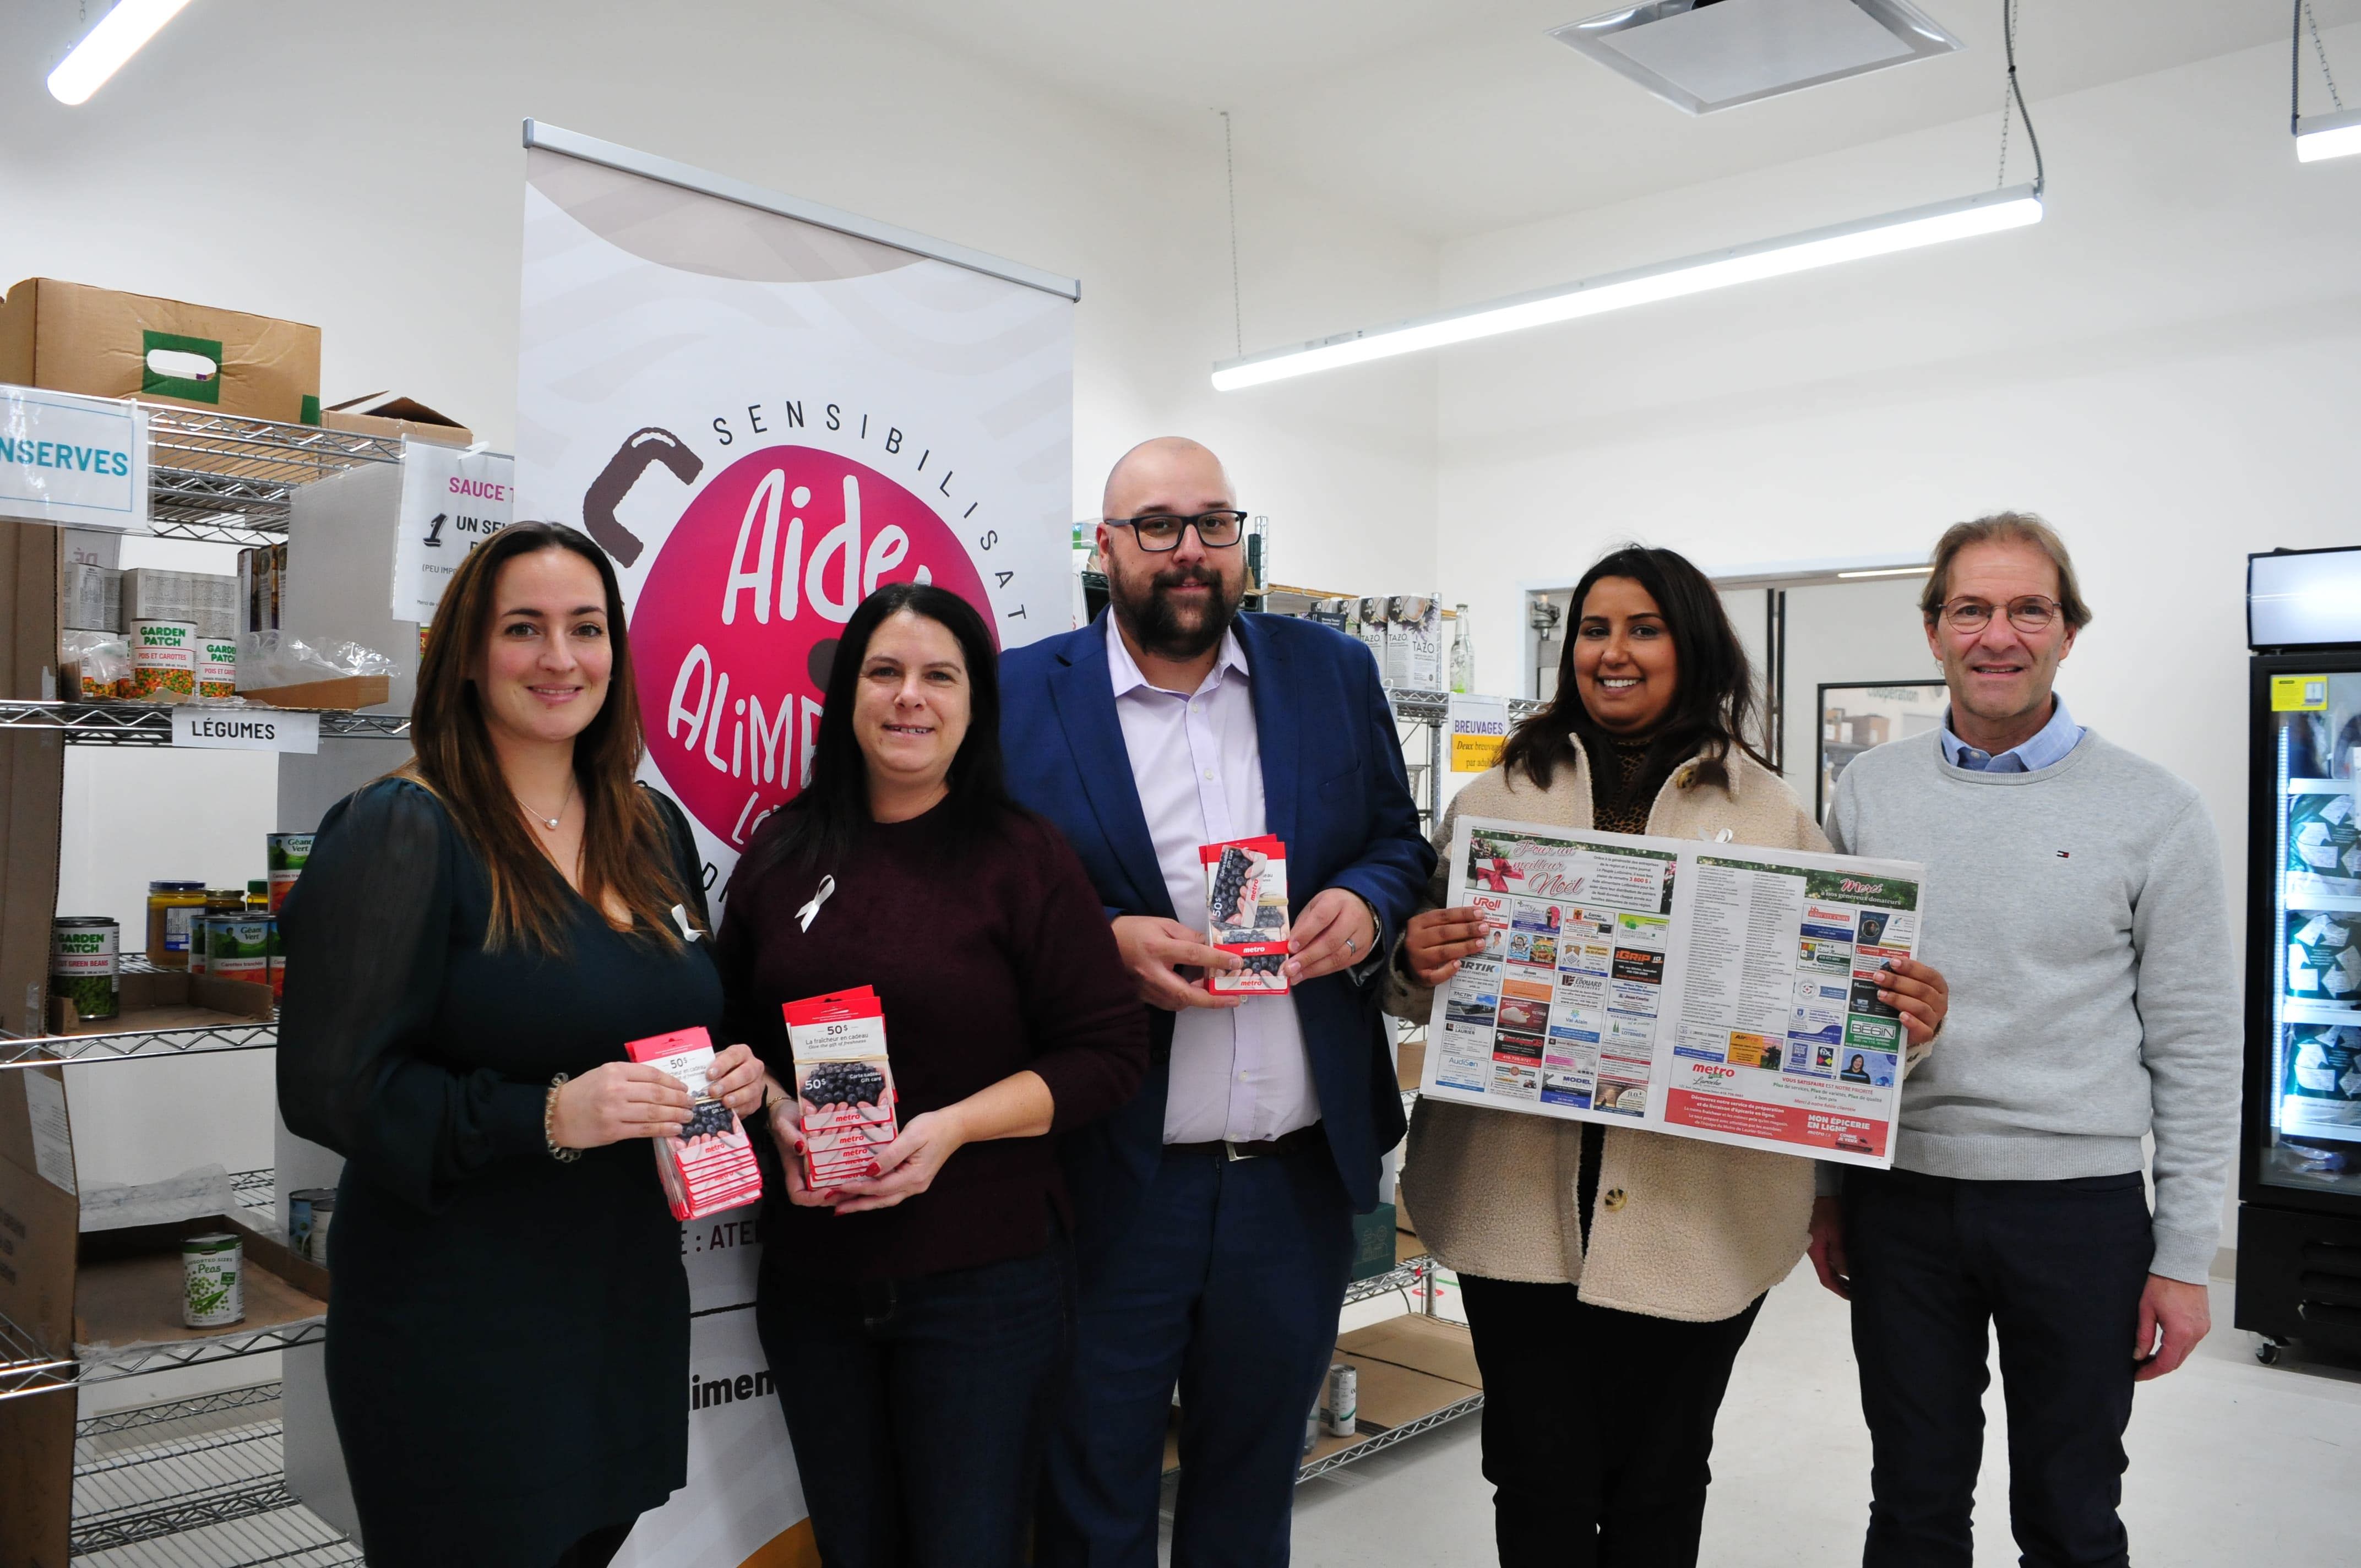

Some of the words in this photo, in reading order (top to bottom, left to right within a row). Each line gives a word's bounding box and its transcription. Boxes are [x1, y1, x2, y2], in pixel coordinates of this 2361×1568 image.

[449, 477, 505, 502] SAUCE
[423, 513, 448, 547] 1
[456, 515, 478, 532] UN
[722, 469, 931, 625] Aide
[422, 564, 439, 573] (PEU
[140, 626, 186, 638] GARDEN
[1389, 634, 1407, 642] TAZO
[144, 636, 181, 646] PATCH
[1413, 641, 1434, 654] TAZO
[192, 720, 275, 741] LÉGUMES
[1455, 720, 1503, 734] BREUVAGES
[1457, 741, 1473, 750] Deux
[1466, 759, 1476, 769] par
[1514, 840, 1557, 856] Pour
[1557, 847, 1576, 855] un
[1513, 859, 1566, 872] meilleur
[1250, 879, 1259, 901] metro
[1528, 872, 1584, 896] Noël
[1841, 878, 1884, 894] Merci
[1473, 897, 1501, 911] URoll
[1838, 892, 1868, 901] généreux
[1869, 896, 1901, 905] donateurs
[1212, 897, 1221, 917] 50$
[58, 934, 105, 943] GARDEN
[62, 944, 99, 953] PATCH
[827, 1025, 848, 1035] 50$
[670, 1057, 688, 1069] 50$
[1449, 1057, 1478, 1067] AudiSon
[1693, 1063, 1735, 1077] metro
[805, 1078, 826, 1090] 50$
[1563, 1076, 1592, 1085] MODEL
[1693, 1076, 1721, 1086] Laroche
[836, 1114, 860, 1122] metro
[1808, 1114, 1829, 1123] MON
[1831, 1117, 1870, 1130] ÉPICERIE
[1821, 1123, 1847, 1132] LIGNE
[840, 1135, 864, 1144] metro
[705, 1144, 725, 1153] metro
[843, 1148, 867, 1157] metro
[198, 1264, 221, 1273] Peas
